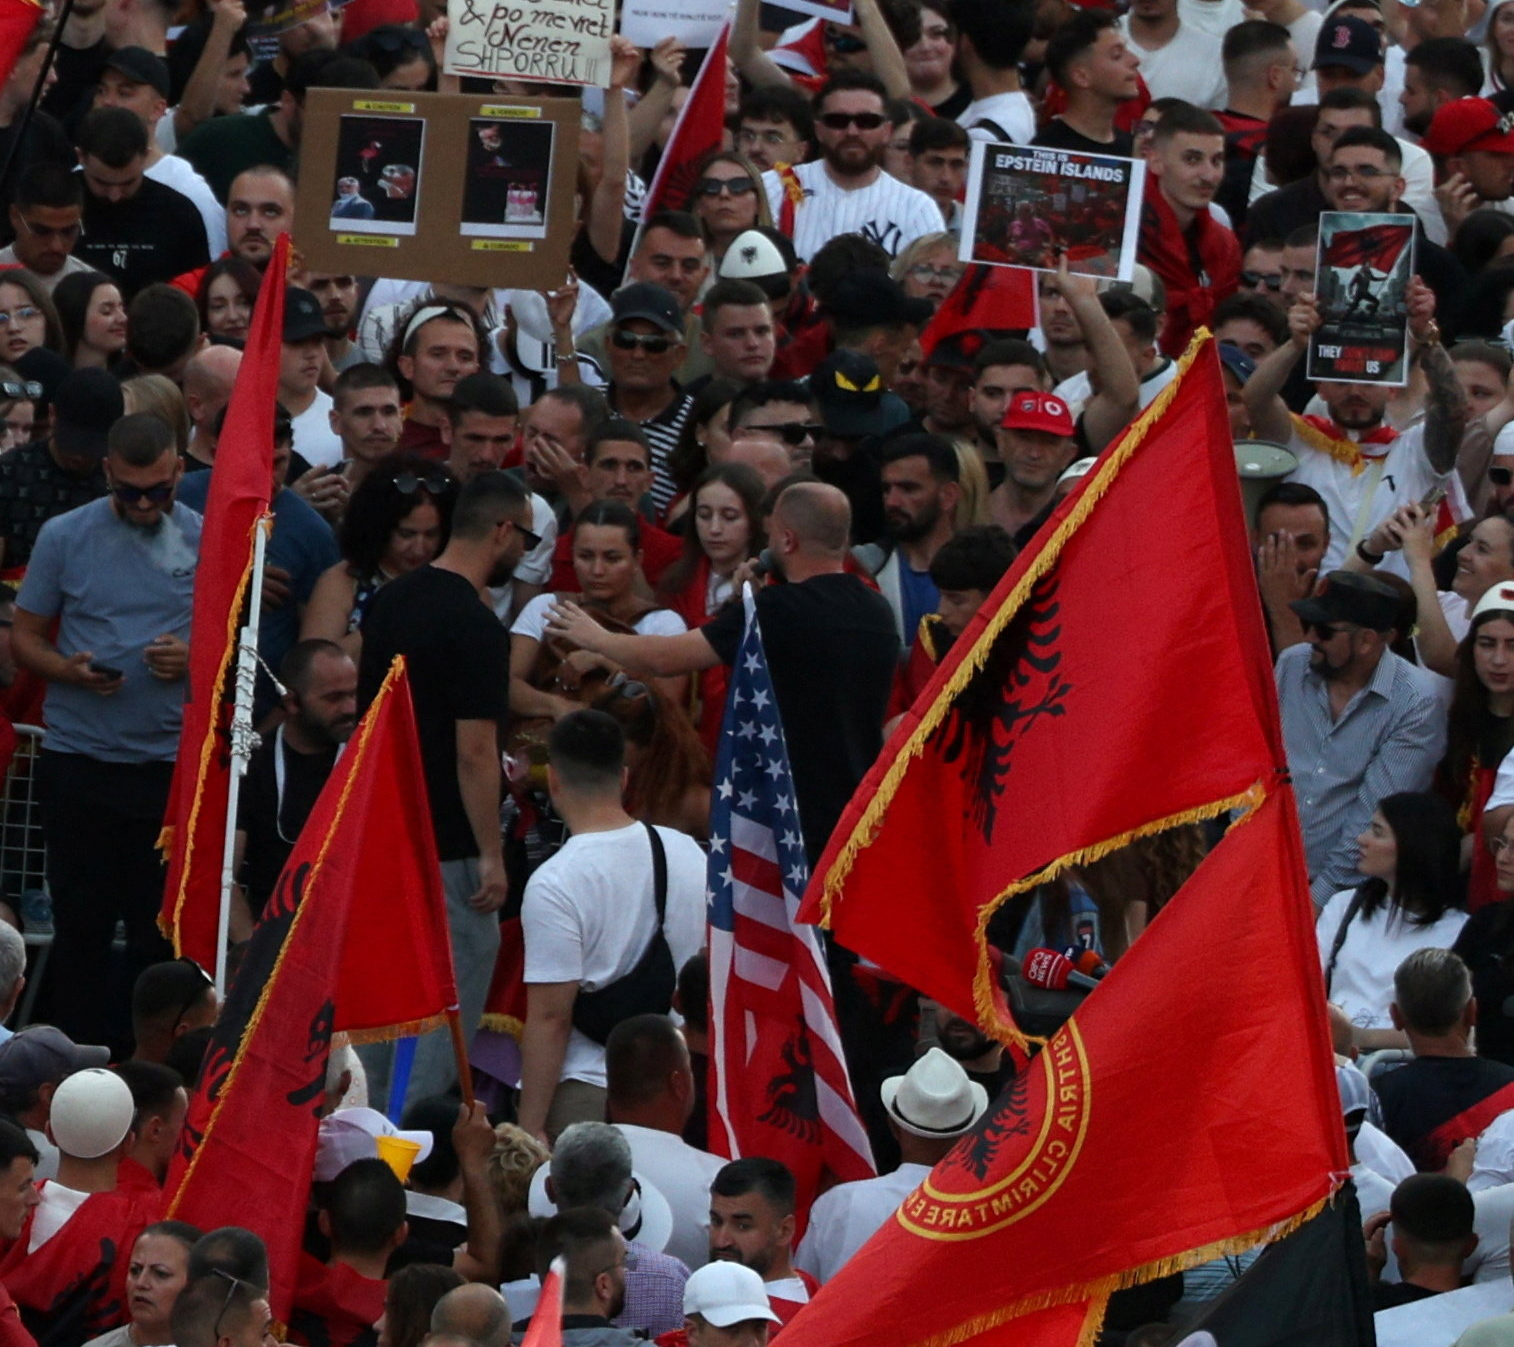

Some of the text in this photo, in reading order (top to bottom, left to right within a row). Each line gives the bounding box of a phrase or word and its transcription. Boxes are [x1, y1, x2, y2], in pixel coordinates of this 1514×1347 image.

[1033, 149, 1068, 161] THIS IS
[995, 154, 1124, 183] EPSTEIN ISLANDS
[1317, 344, 1342, 358] THEY
[1366, 360, 1380, 373] US
